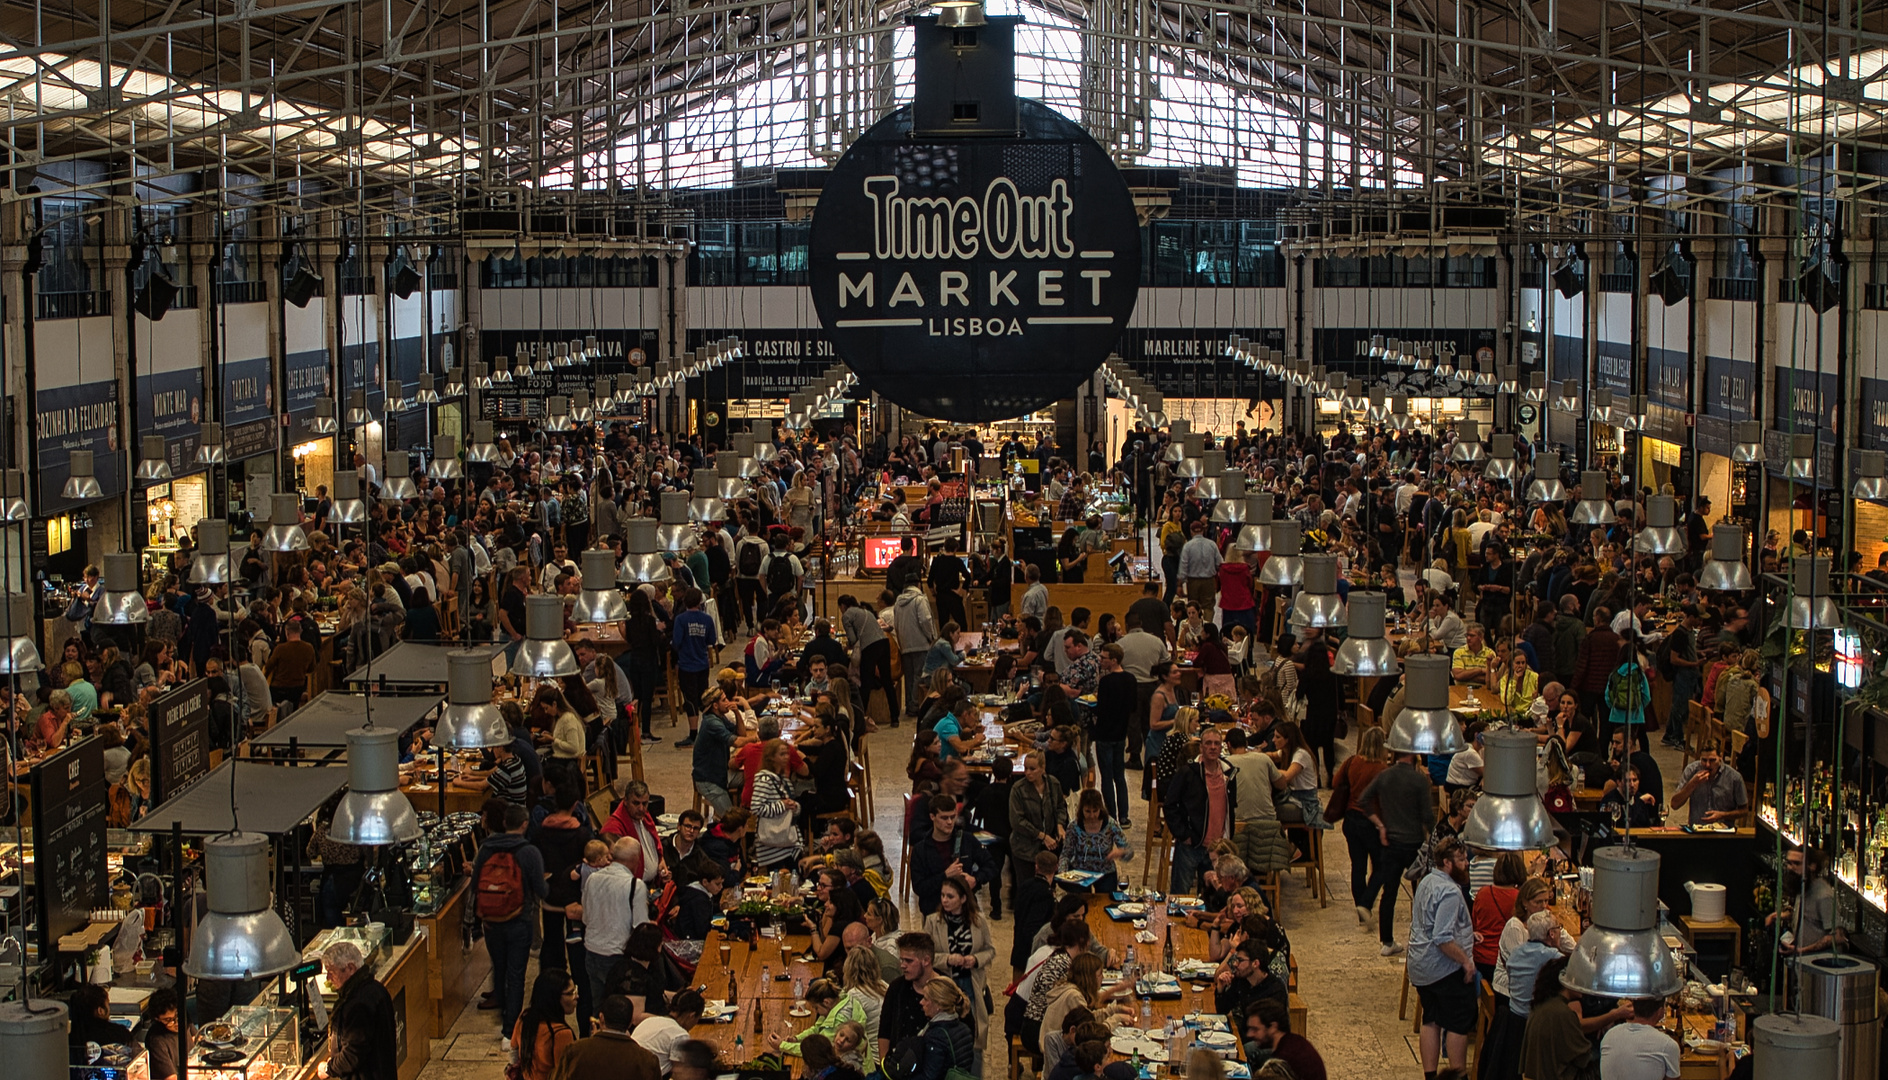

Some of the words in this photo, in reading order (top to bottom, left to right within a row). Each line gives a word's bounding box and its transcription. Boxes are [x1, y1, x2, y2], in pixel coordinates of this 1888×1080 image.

[838, 269, 1111, 308] MARKET
[929, 318, 1024, 338] LISBOA
[594, 341, 623, 357] ILVA
[755, 340, 800, 357] CASTRO
[805, 341, 812, 357] E
[1144, 340, 1203, 356] MARLENE
[299, 368, 305, 389] DE
[527, 380, 553, 388] FOOD
[778, 376, 792, 386] SEM
[1720, 374, 1731, 398] ZER
[1732, 377, 1746, 401] ZERO
[153, 390, 174, 418] MONTE
[174, 388, 187, 413] MAR
[37, 408, 67, 441] COZINHA
[68, 406, 79, 435] DA
[79, 400, 117, 432] FELICIDADE
[68, 758, 80, 781] CHEF
